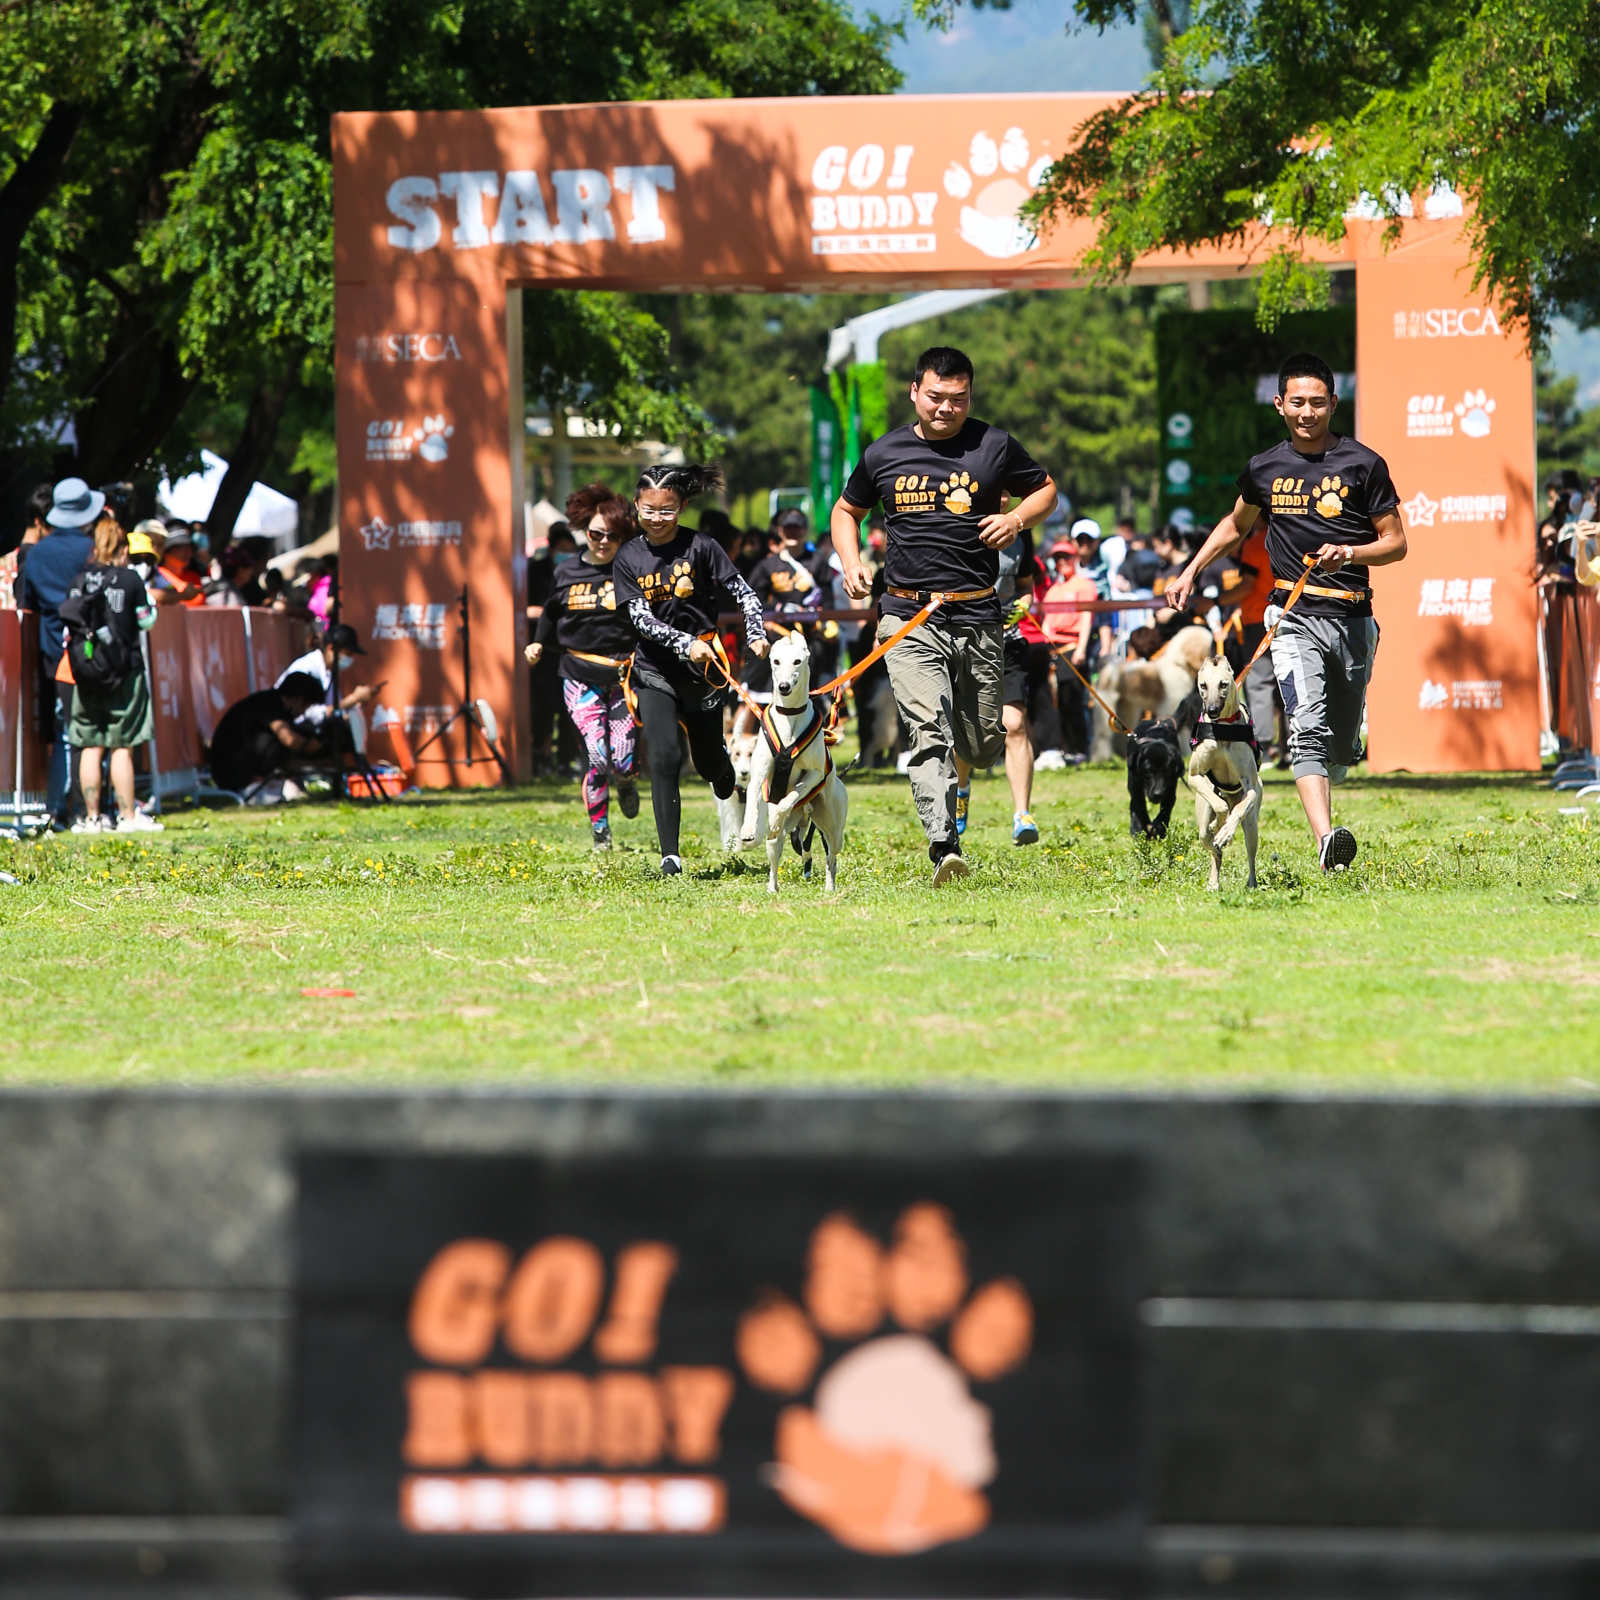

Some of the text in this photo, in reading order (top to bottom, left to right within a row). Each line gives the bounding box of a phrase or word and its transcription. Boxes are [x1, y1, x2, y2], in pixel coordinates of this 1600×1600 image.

[811, 144, 914, 191] GO!
[386, 165, 675, 254] START
[811, 192, 938, 230] BUDDY
[1426, 307, 1502, 337] SECA
[387, 333, 462, 362] SECA
[1408, 395, 1445, 413] GO!
[895, 475, 929, 491] GO!
[895, 491, 937, 504] BUDDY
[1272, 477, 1305, 493] GO!
[1271, 494, 1310, 506] BUDDY
[408, 1236, 677, 1364] GO!
[404, 1365, 734, 1467] BUDDY
